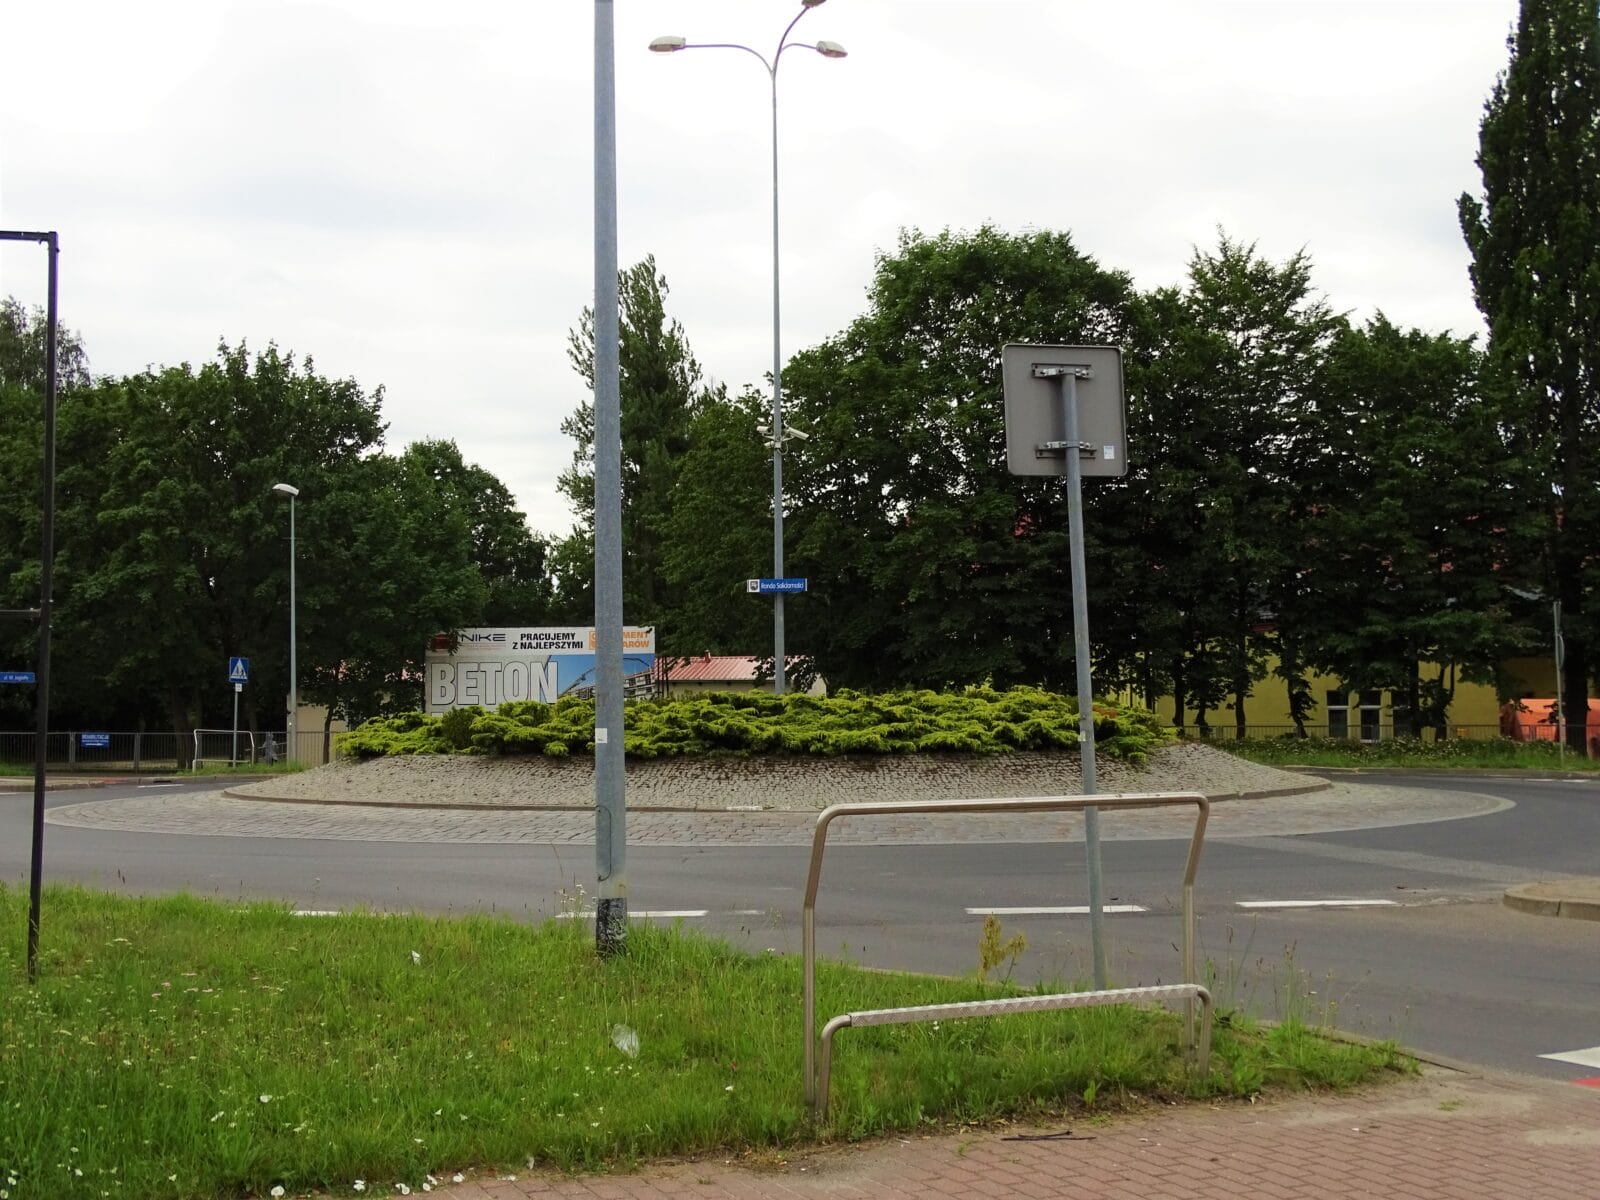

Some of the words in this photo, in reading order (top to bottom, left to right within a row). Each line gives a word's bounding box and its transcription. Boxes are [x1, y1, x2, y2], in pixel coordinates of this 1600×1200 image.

[520, 632, 576, 641] PRACUJEMY
[623, 631, 648, 639] MENT
[512, 642, 518, 650] Z
[520, 641, 584, 650] NAJLEPSZYMI
[431, 660, 558, 705] BETON
